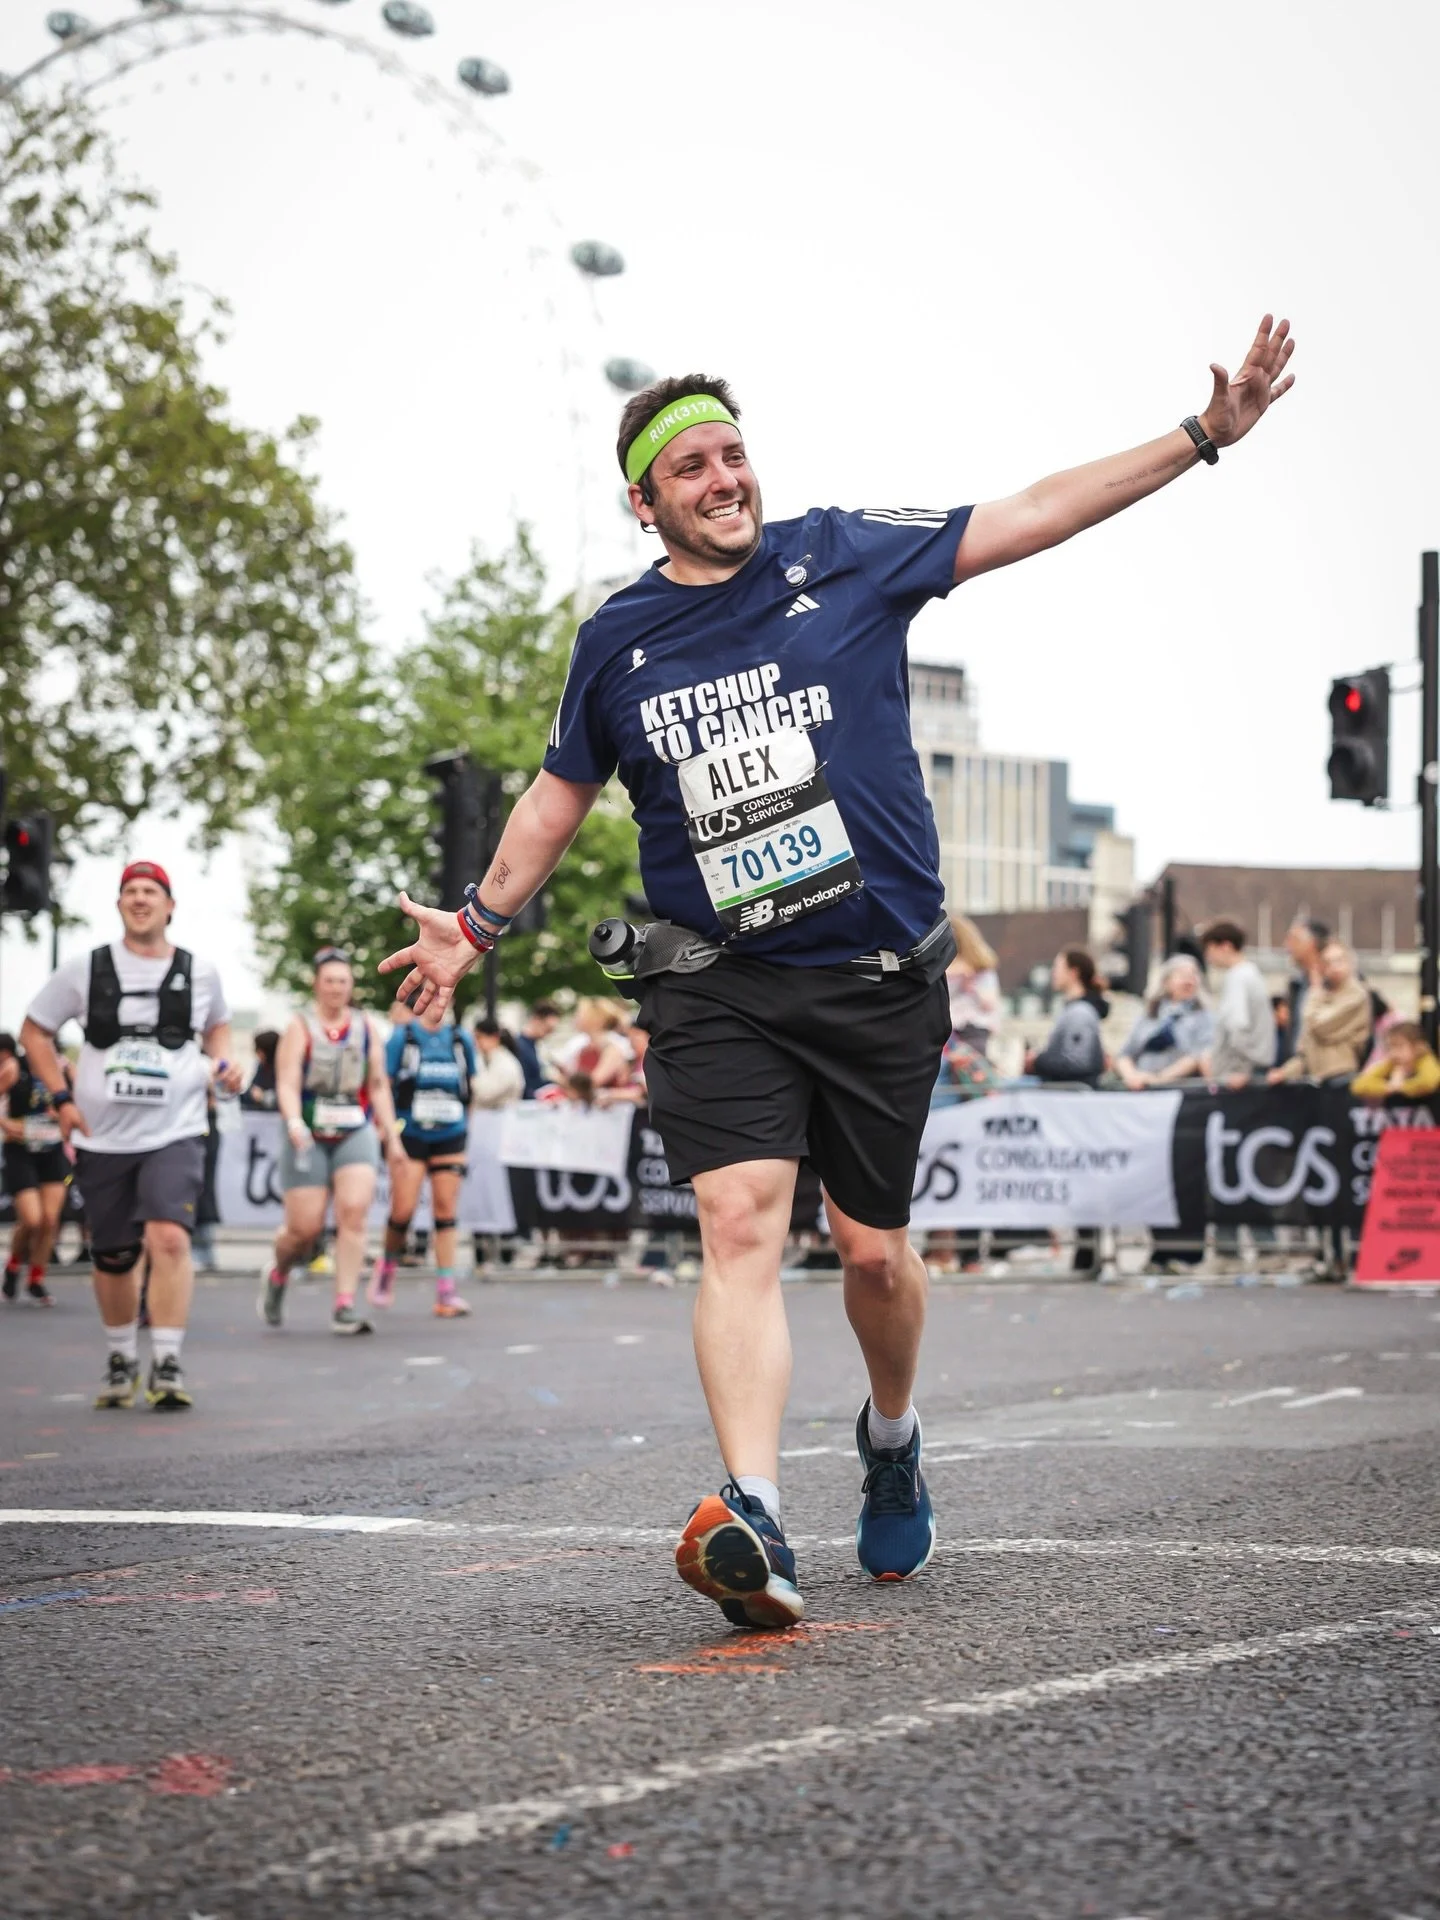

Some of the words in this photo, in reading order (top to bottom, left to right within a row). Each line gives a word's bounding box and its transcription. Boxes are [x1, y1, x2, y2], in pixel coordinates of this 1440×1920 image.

[640, 662, 781, 733] KETCHUP
[646, 723, 693, 761] TO
[697, 685, 833, 752] CANCER
[707, 745, 779, 800] ALEX
[746, 798, 794, 825] SERVICES
[720, 825, 822, 888] 70139
[778, 901, 802, 918] new
[802, 880, 851, 908] balance
[115, 1081, 164, 1097] Liam
[1204, 1108, 1342, 1207] tcs
